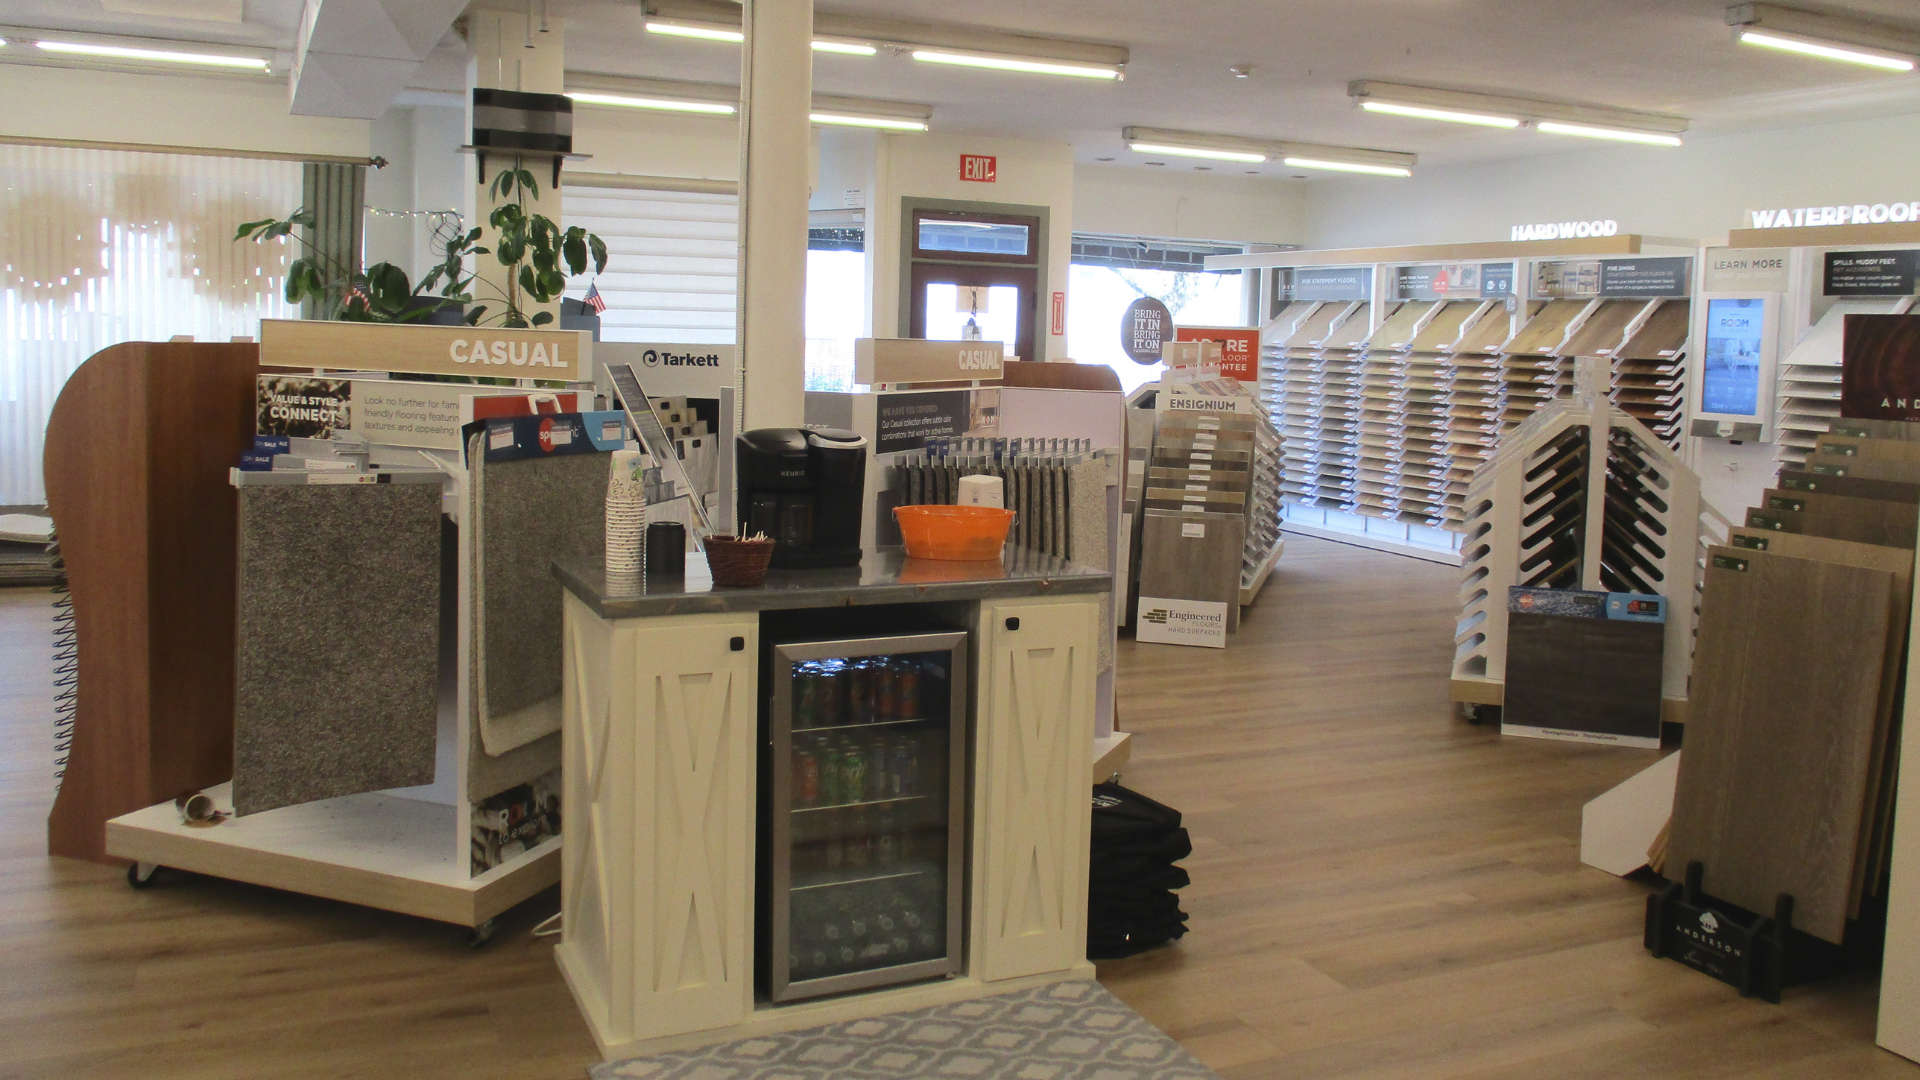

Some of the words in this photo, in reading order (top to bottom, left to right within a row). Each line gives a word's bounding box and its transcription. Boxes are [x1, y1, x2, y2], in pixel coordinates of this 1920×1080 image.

[965, 157, 991, 179] EXIT
[1751, 201, 1920, 229] WATERPROOF
[1511, 219, 1618, 241] HARDWOOD
[1714, 261, 1748, 270] LEARN
[1752, 259, 1782, 269] MORE
[1134, 309, 1161, 319] BRING
[1134, 318, 1147, 330] IT
[1147, 319, 1161, 330] IN
[1133, 330, 1161, 340] BRING
[1133, 339, 1144, 349] IT
[1145, 339, 1160, 349] ON
[449, 339, 568, 368] CASUAL
[661, 352, 719, 367] Tarkett
[959, 350, 1000, 370] CASUAL
[1221, 354, 1248, 362] LOOR
[270, 395, 300, 405] VALUE
[301, 396, 307, 405] &
[308, 397, 338, 406] STYLE
[364, 396, 384, 404] Look
[386, 397, 397, 406] no
[398, 398, 426, 407] further
[428, 399, 440, 408] for
[442, 401, 460, 410] fami
[1170, 398, 1236, 411] ENSIGNIUM
[270, 406, 337, 422] CONNECT
[364, 408, 394, 419] friendly
[395, 410, 427, 421] flooring
[428, 412, 460, 422] featurin
[883, 408, 891, 416] WE
[892, 407, 905, 416] HAVE
[906, 406, 916, 415] YOU
[916, 405, 938, 414] COVERED
[364, 421, 396, 431] textures
[397, 423, 413, 432] and
[414, 425, 455, 436] appealing
[882, 420, 890, 429] Our
[891, 419, 904, 428] Casual
[904, 418, 921, 427] collection
[932, 416, 943, 424] subtle
[943, 415, 953, 423] color
[882, 430, 908, 440] combinations
[916, 429, 925, 437] work
[1169, 610, 1222, 622] Engineered
[1187, 628, 1221, 636] SURFACES
[499, 832, 509, 845] to
[511, 814, 547, 839] explore
[1676, 925, 1741, 957] ANDERSON
